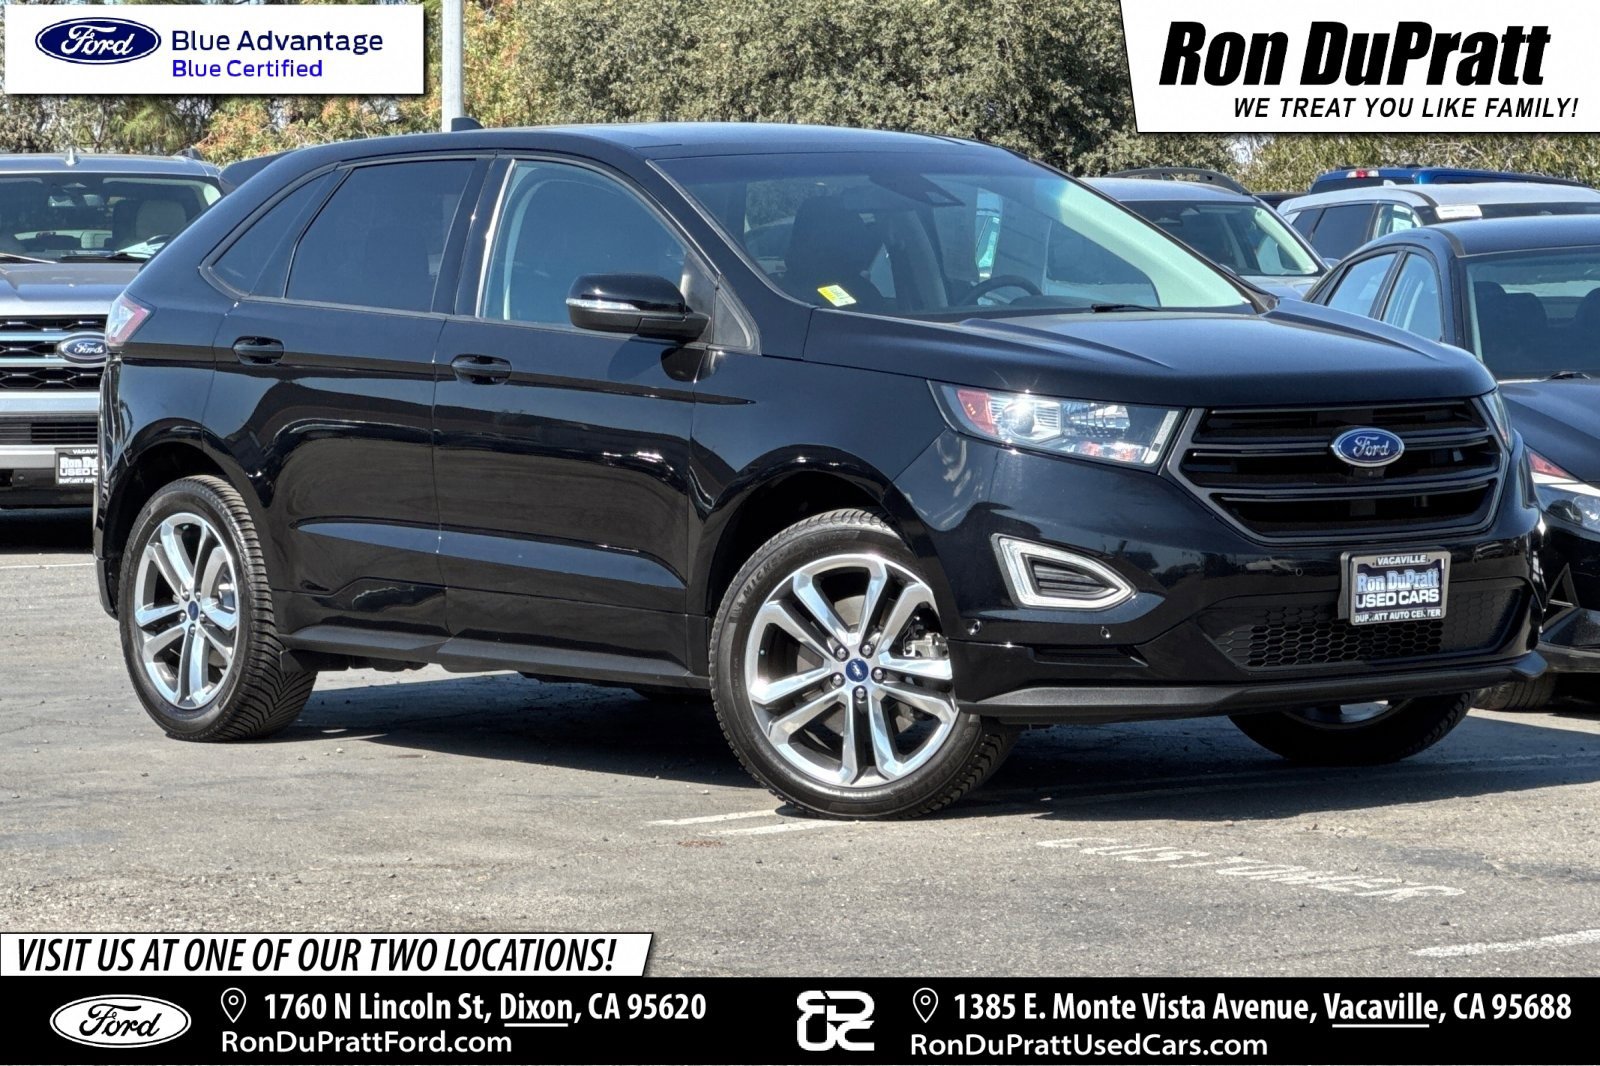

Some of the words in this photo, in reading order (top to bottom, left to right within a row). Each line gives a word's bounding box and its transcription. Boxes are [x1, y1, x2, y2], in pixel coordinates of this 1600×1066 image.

[1353, 435, 1390, 458] Ford
[60, 468, 90, 477] USED
[1377, 554, 1426, 566] VACAVILLE
[1356, 572, 1386, 593] Ron
[1387, 567, 1440, 592] DuPratt
[1356, 592, 1397, 608] USED
[1398, 588, 1440, 605] CARS
[1355, 612, 1389, 623] DUPATT
[1389, 610, 1410, 620] AUTO
